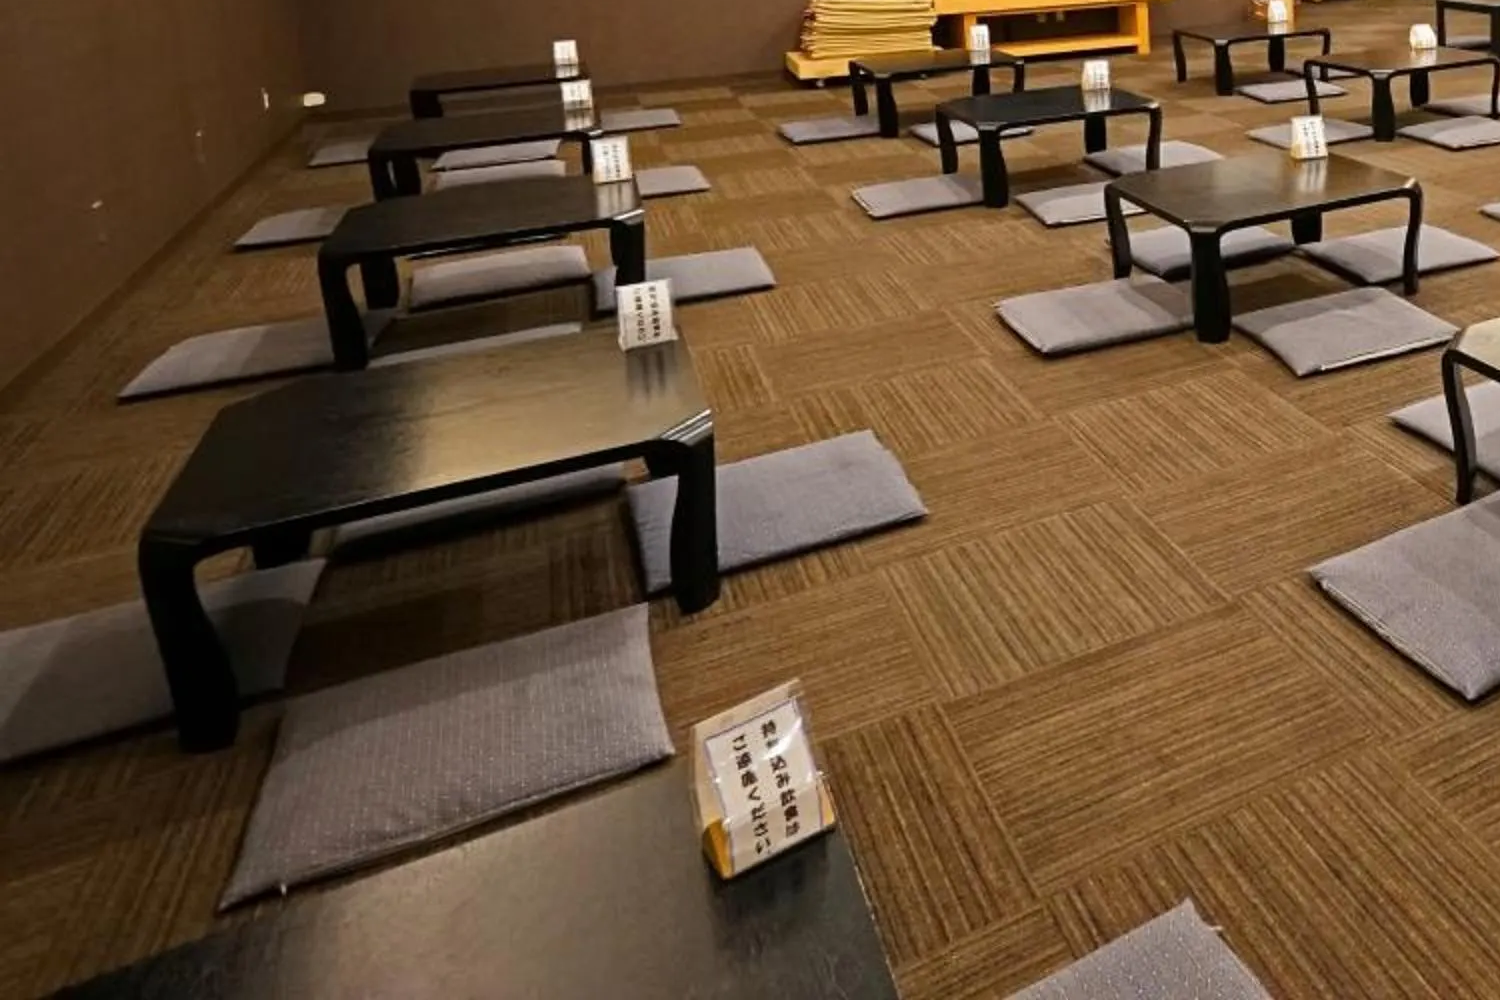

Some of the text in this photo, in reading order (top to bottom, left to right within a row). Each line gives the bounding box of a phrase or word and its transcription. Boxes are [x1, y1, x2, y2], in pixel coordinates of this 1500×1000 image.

[733, 735, 771, 854] ご遠慮ください
